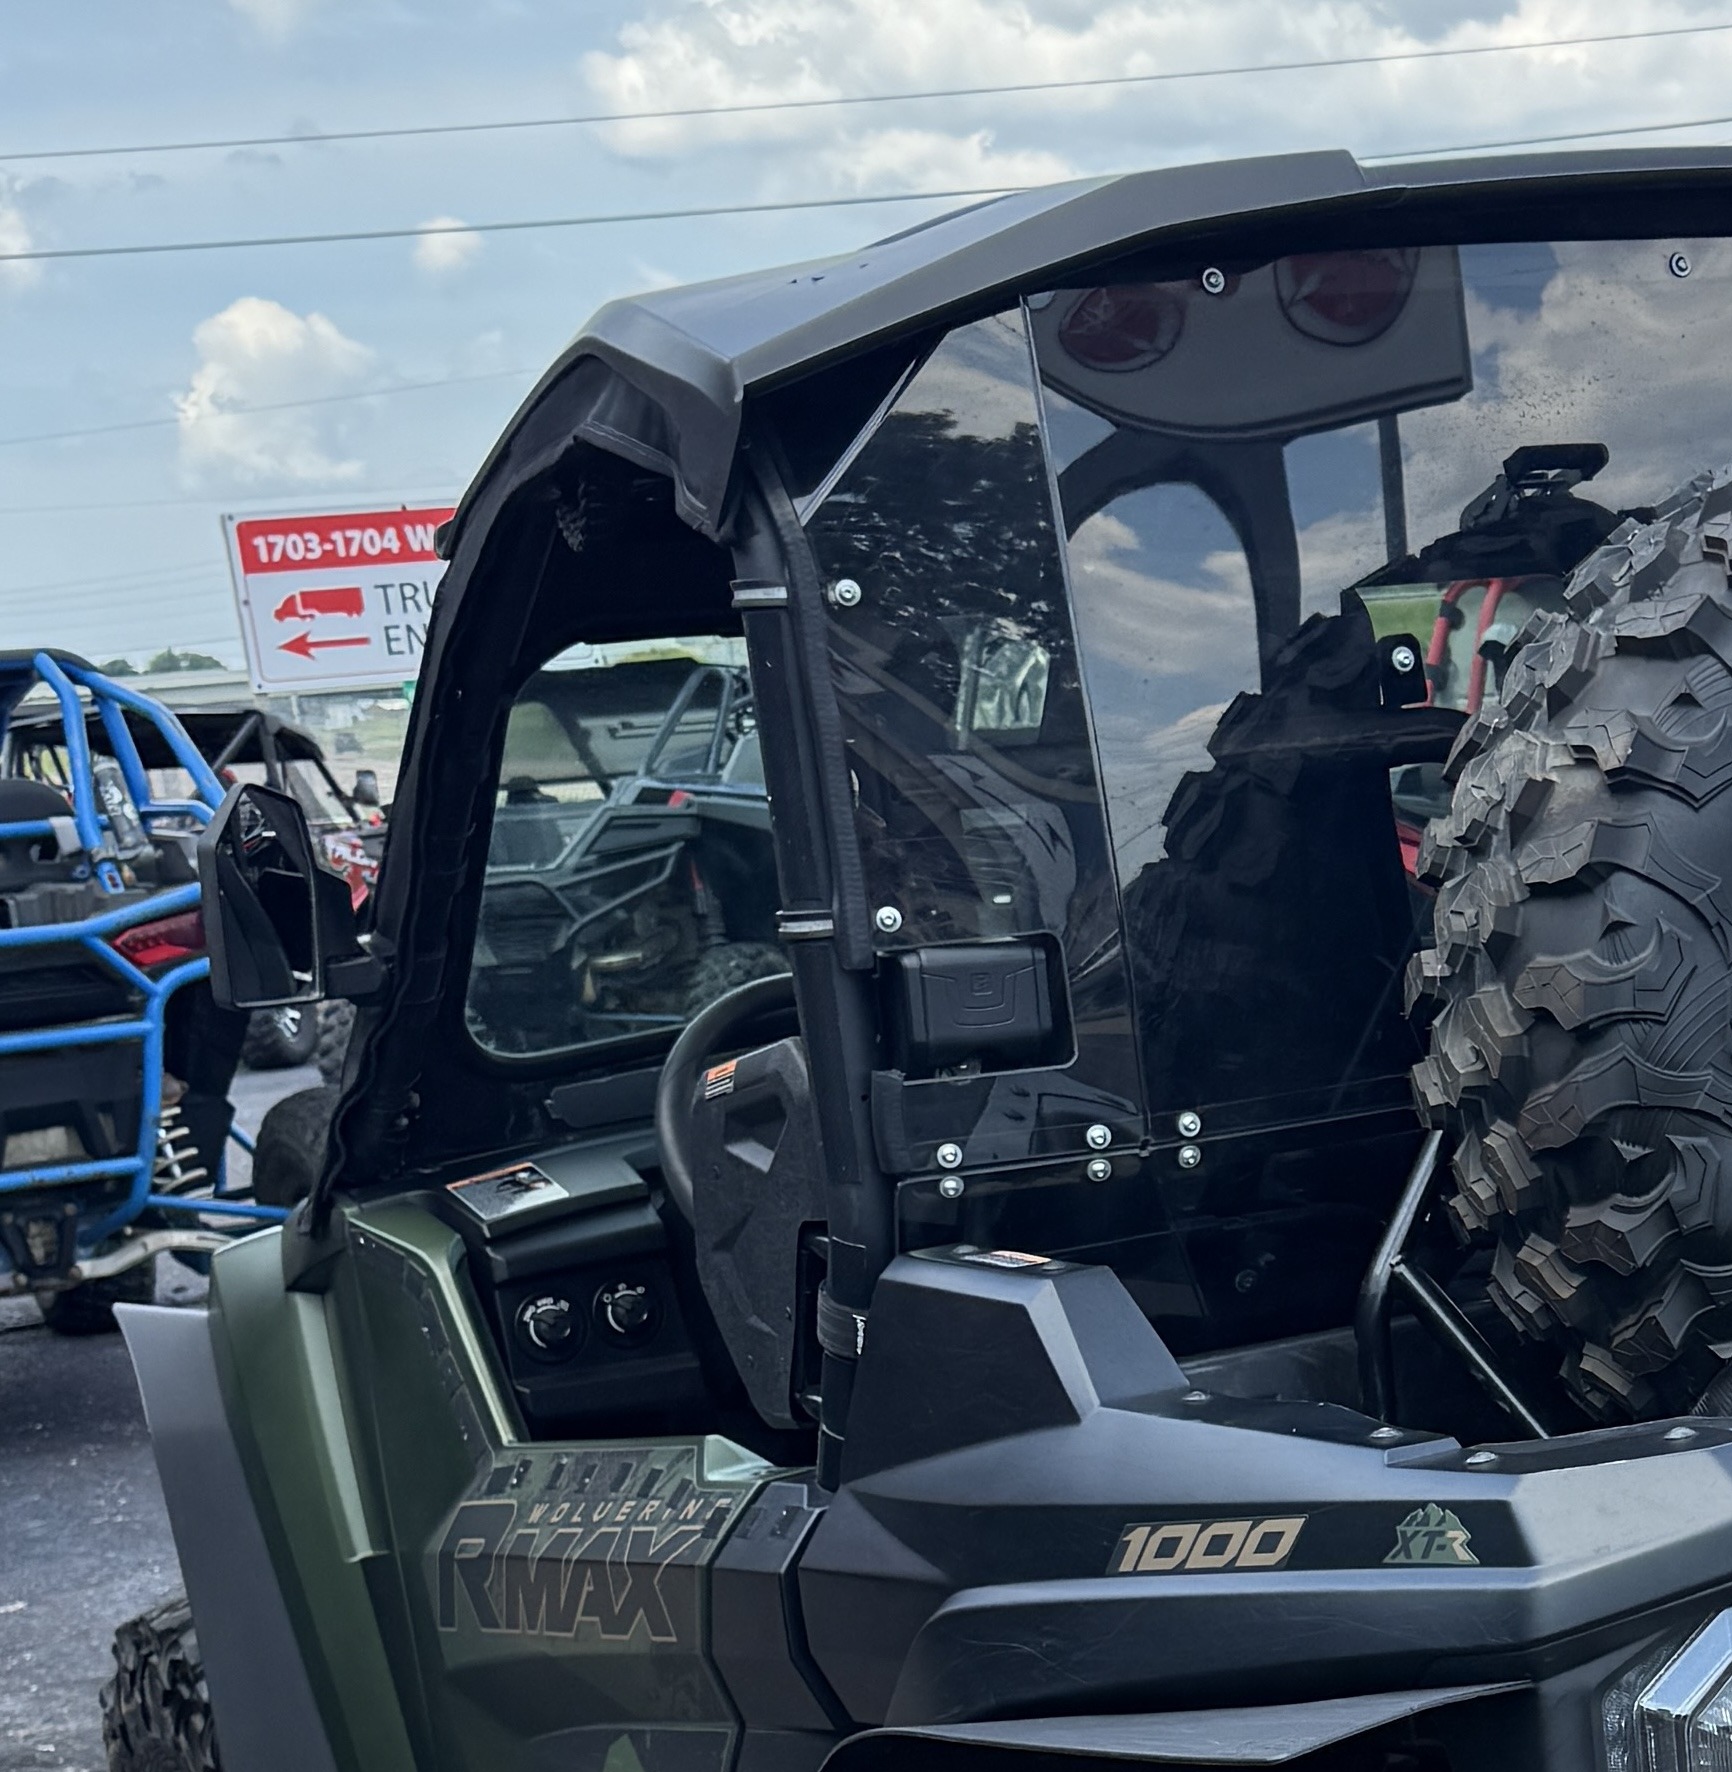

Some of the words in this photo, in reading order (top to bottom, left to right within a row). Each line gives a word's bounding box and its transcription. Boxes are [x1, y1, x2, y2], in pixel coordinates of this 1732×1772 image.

[253, 526, 402, 563] 1703-1704
[438, 1500, 704, 1642] RMAX
[1118, 1517, 1307, 1573] 1000
